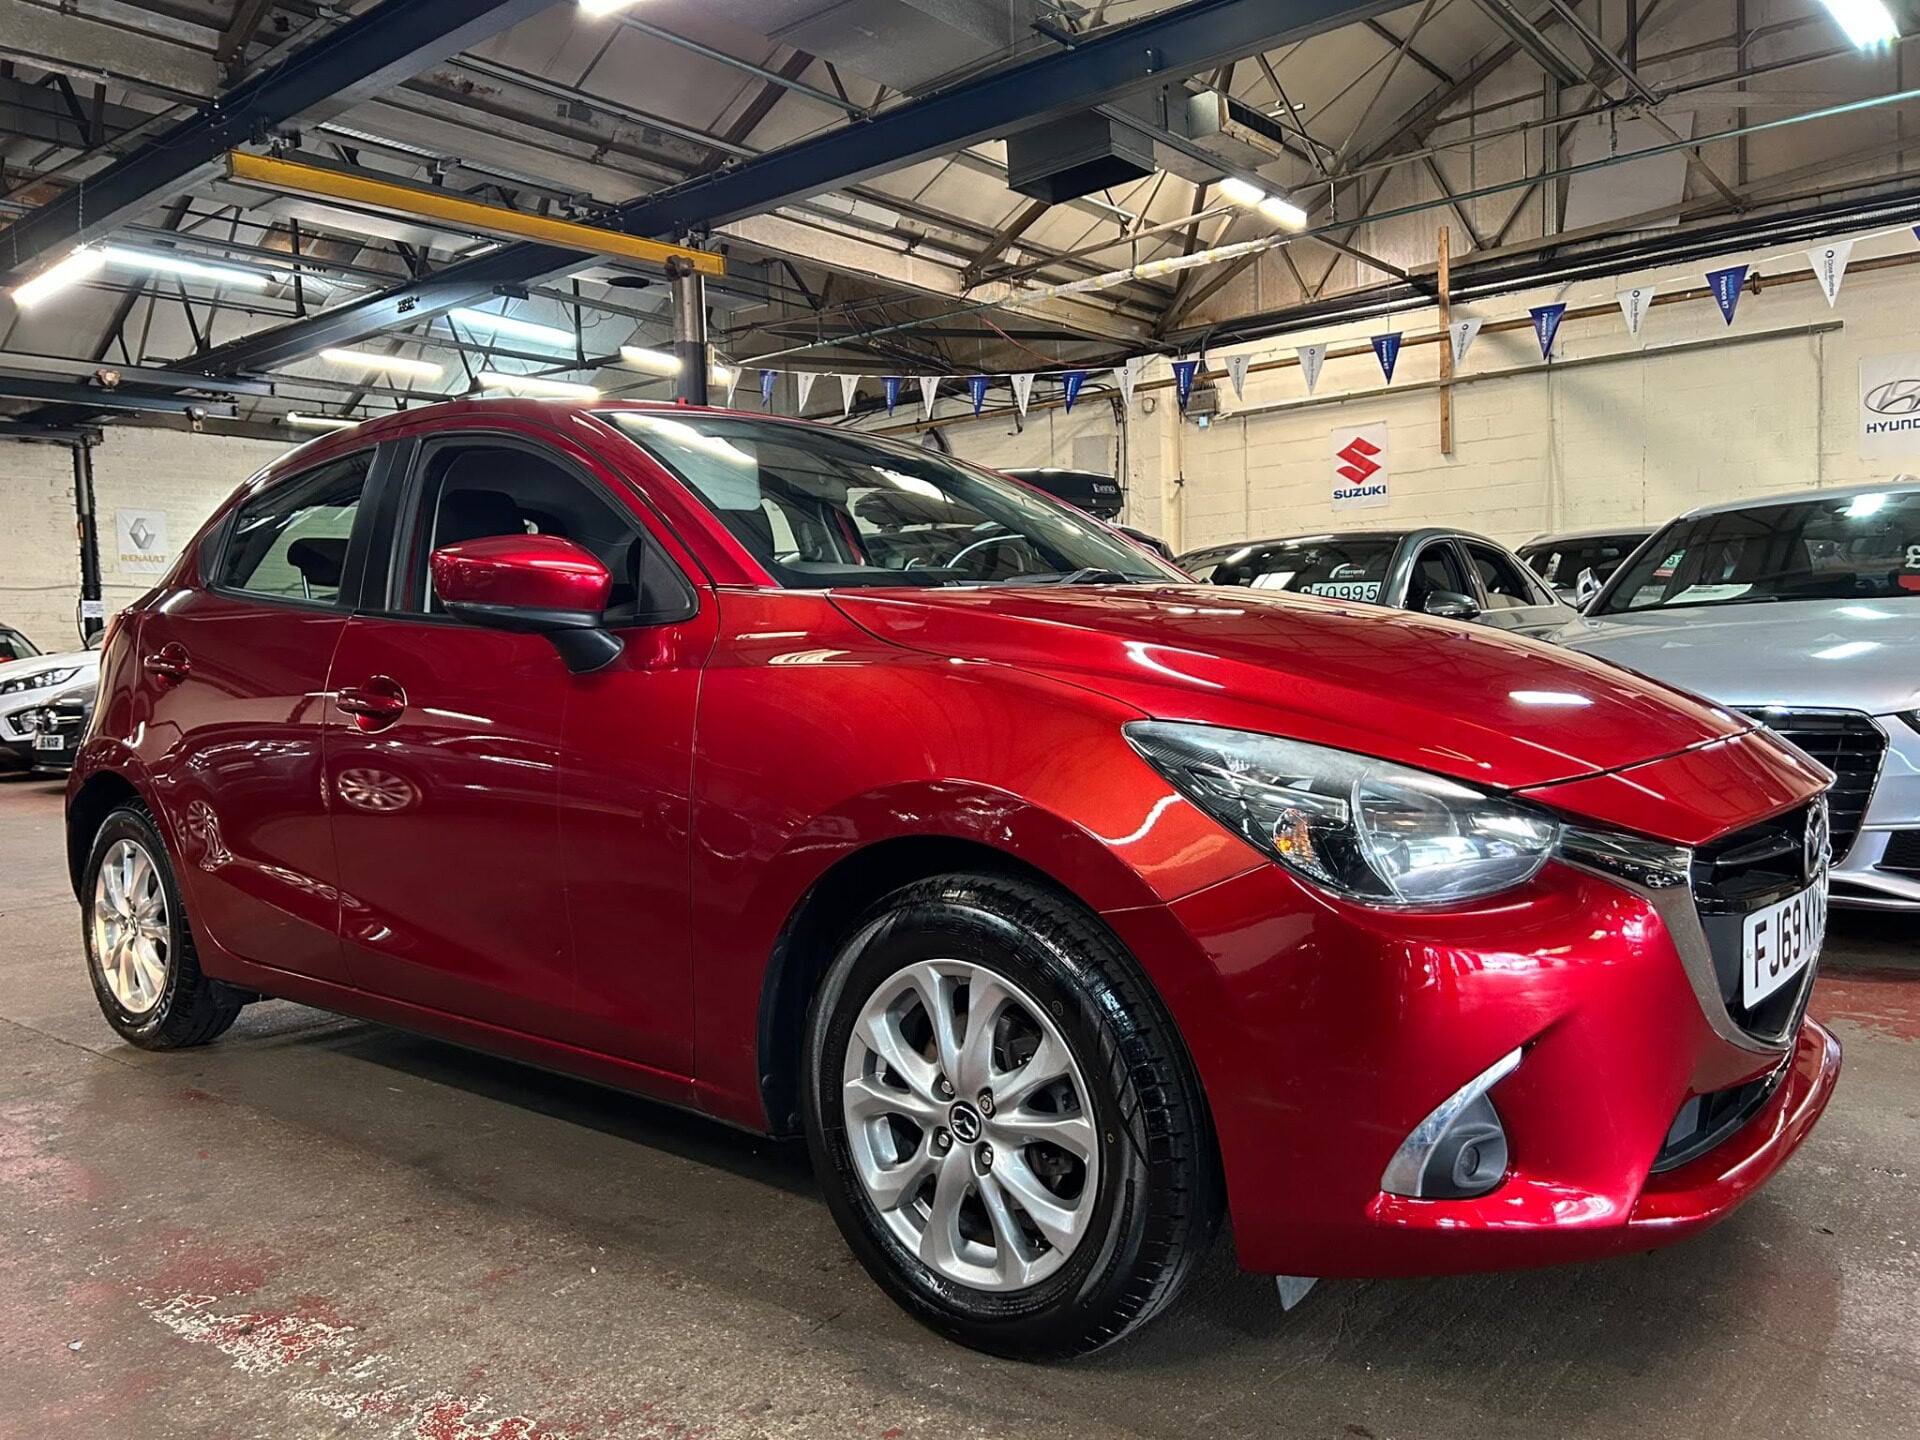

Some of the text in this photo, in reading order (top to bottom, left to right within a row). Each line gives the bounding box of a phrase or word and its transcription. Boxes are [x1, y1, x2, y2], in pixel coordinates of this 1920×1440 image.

[1333, 485, 1387, 500] SUZUKI
[121, 554, 167, 564] RENAULT
[1754, 898, 1801, 990] FJ69
